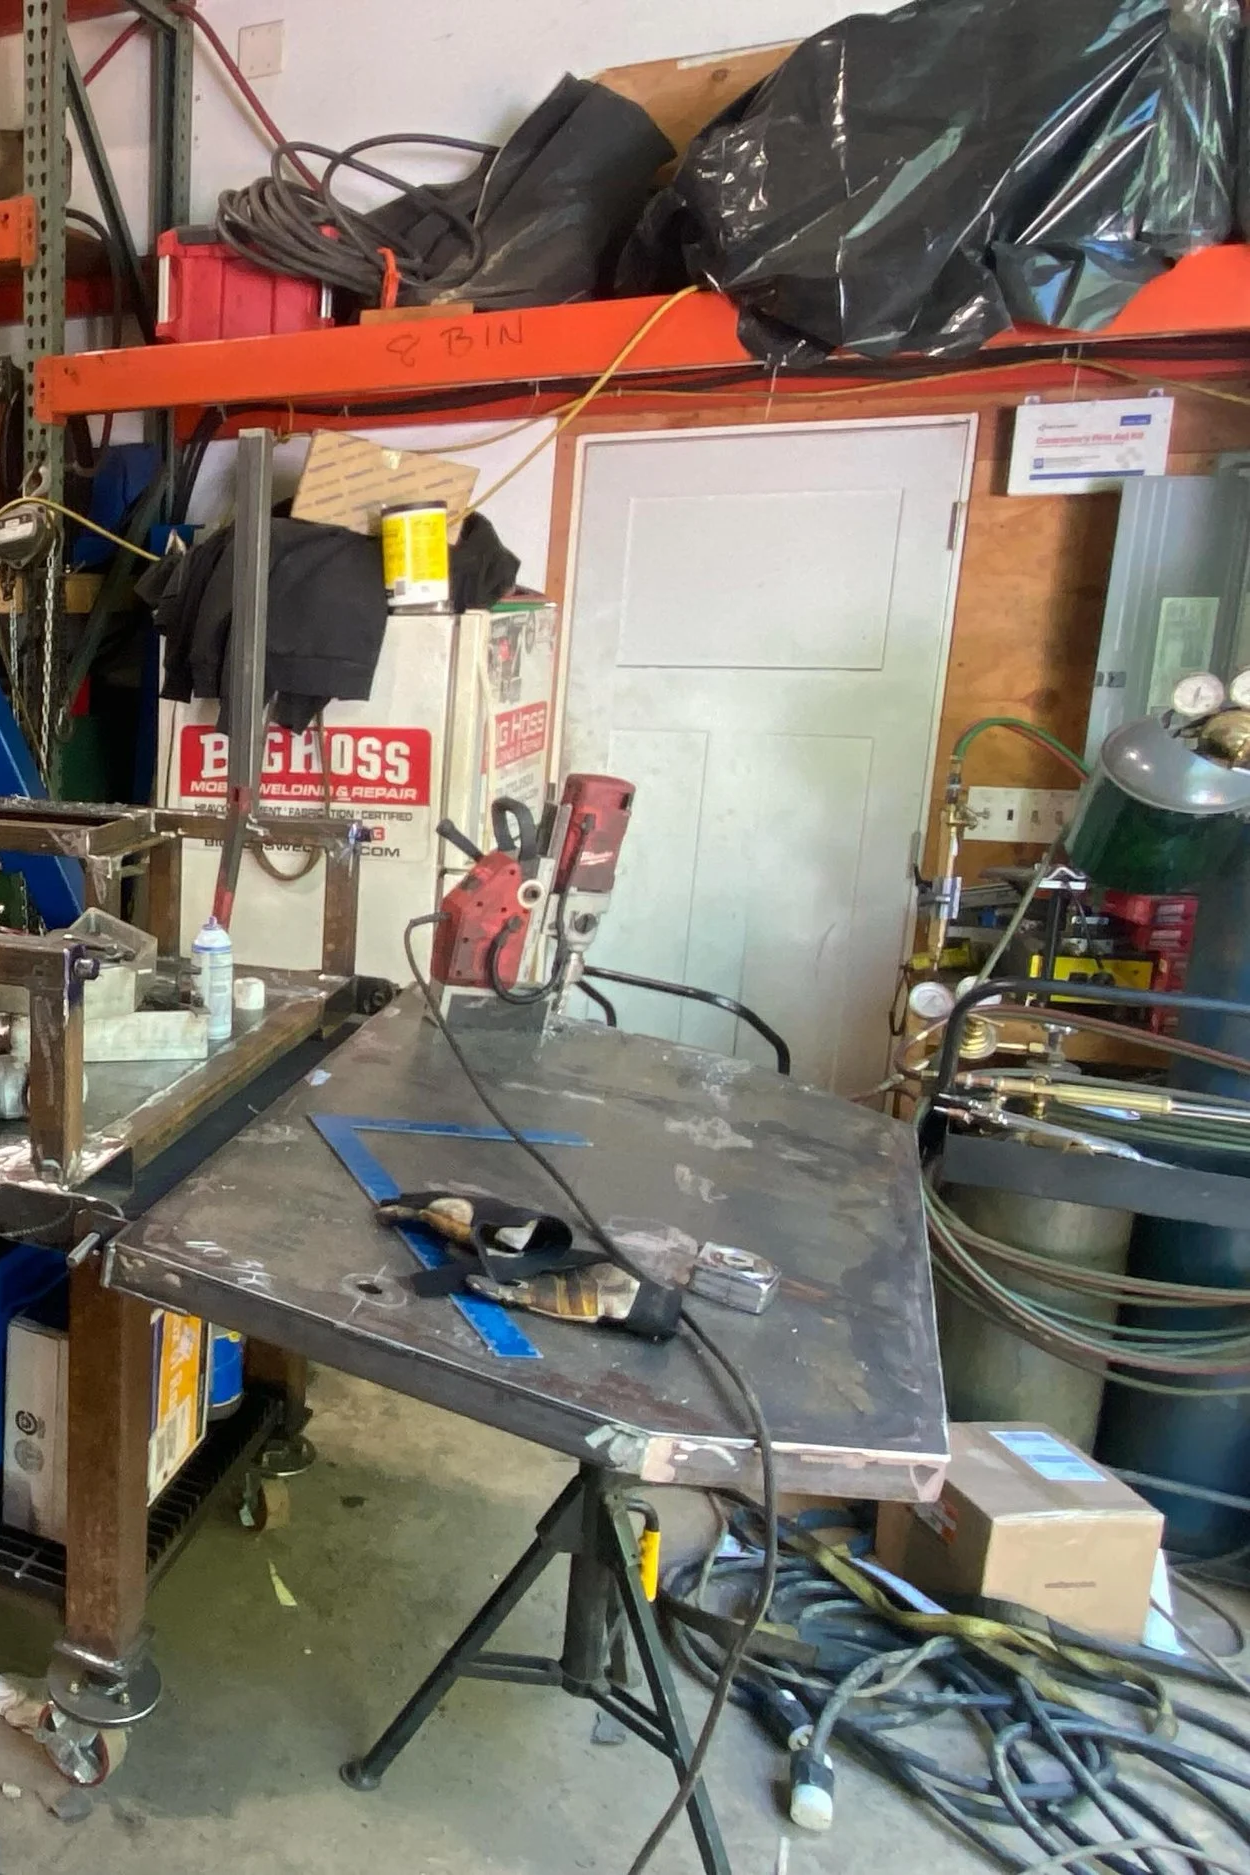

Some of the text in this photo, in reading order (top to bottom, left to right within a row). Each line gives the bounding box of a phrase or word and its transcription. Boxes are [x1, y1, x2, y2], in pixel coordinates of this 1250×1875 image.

[439, 312, 523, 358] BIN
[201, 733, 283, 779] BG
[259, 784, 333, 798] WELDIN
[336, 786, 350, 800] &
[351, 786, 418, 800] REPAIR
[288, 807, 354, 819] FABRICTION
[360, 809, 414, 822] CERTIFIED
